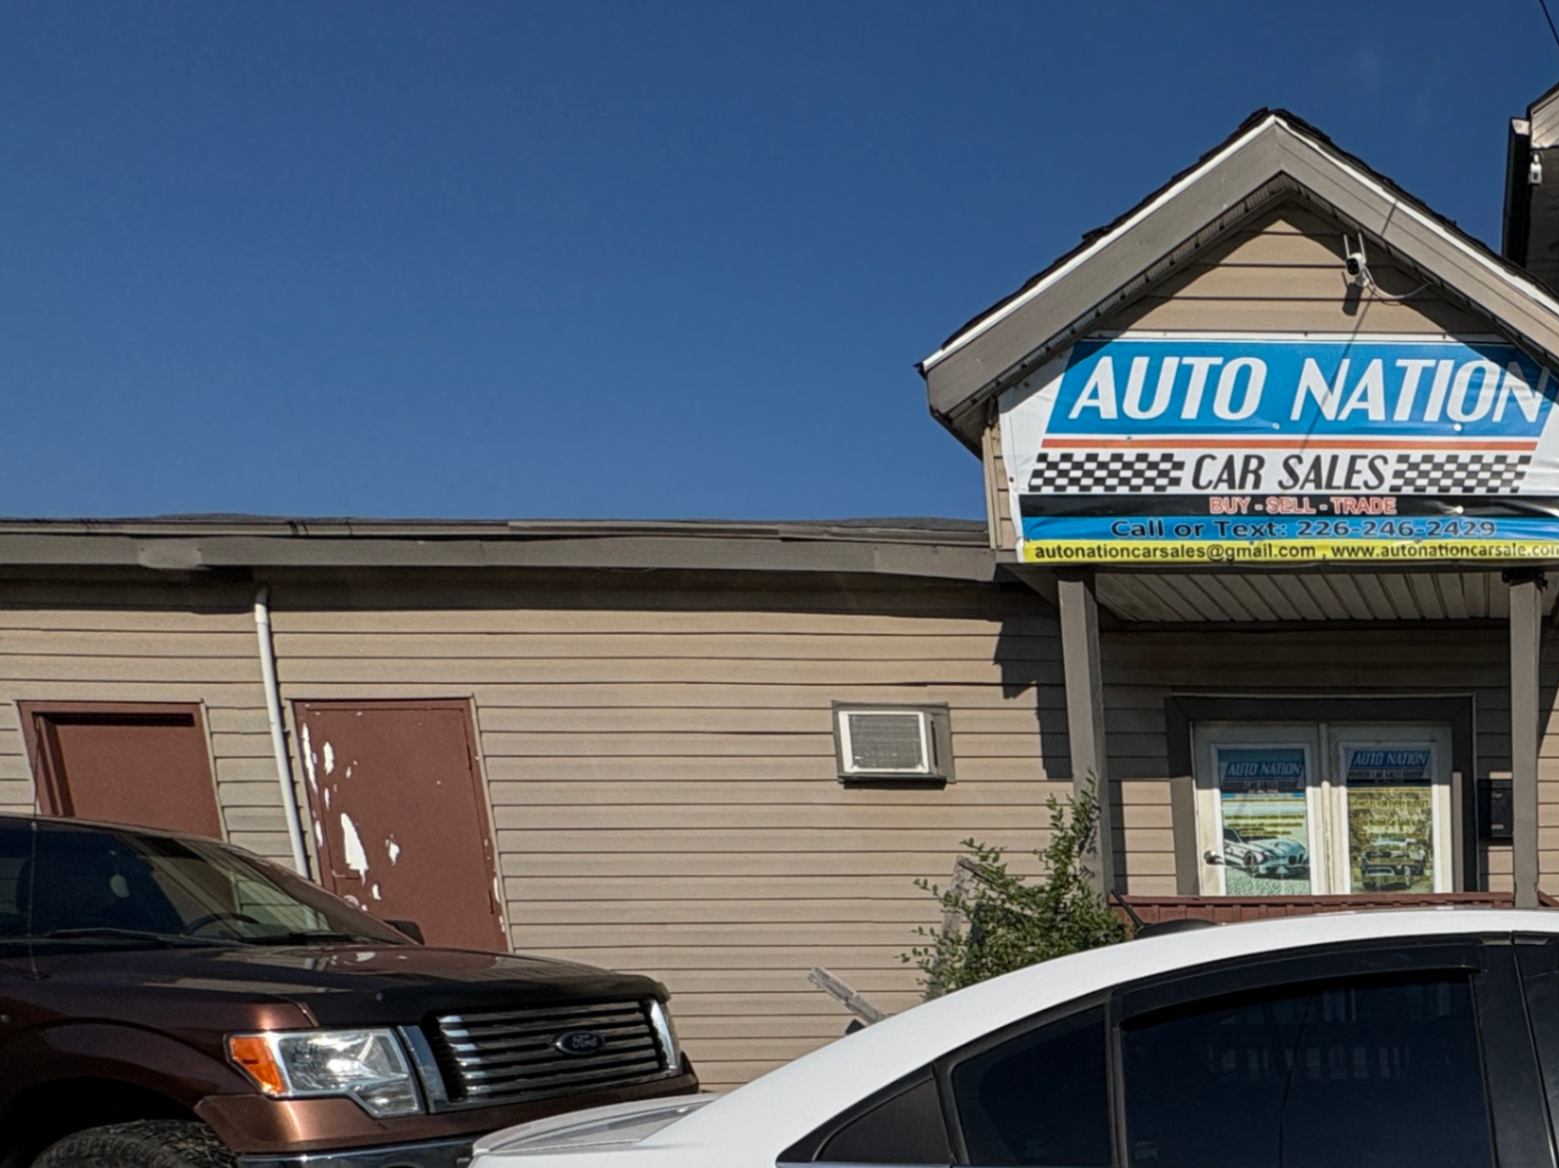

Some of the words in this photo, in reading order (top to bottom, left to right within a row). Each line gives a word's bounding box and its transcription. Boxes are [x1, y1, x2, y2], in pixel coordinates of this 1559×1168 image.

[1068, 356, 1267, 421] AUTO
[1290, 357, 1552, 423] NATION
[1191, 454, 1265, 490] CAR
[1278, 454, 1388, 491] SALES
[1209, 496, 1251, 515] BUY
[1266, 496, 1316, 515] SELL
[1330, 496, 1398, 515] TRADE
[1111, 520, 1164, 538] Call
[1174, 523, 1205, 538] or
[1214, 520, 1287, 538] Text:
[1297, 520, 1496, 538] 226-246-2429
[1035, 543, 1316, 562] autonationcarsales@gmail.com
[1227, 762, 1259, 776] AUTO
[1261, 761, 1303, 777] NATION
[1354, 752, 1384, 766] AUTO
[1386, 752, 1428, 767] NATION
